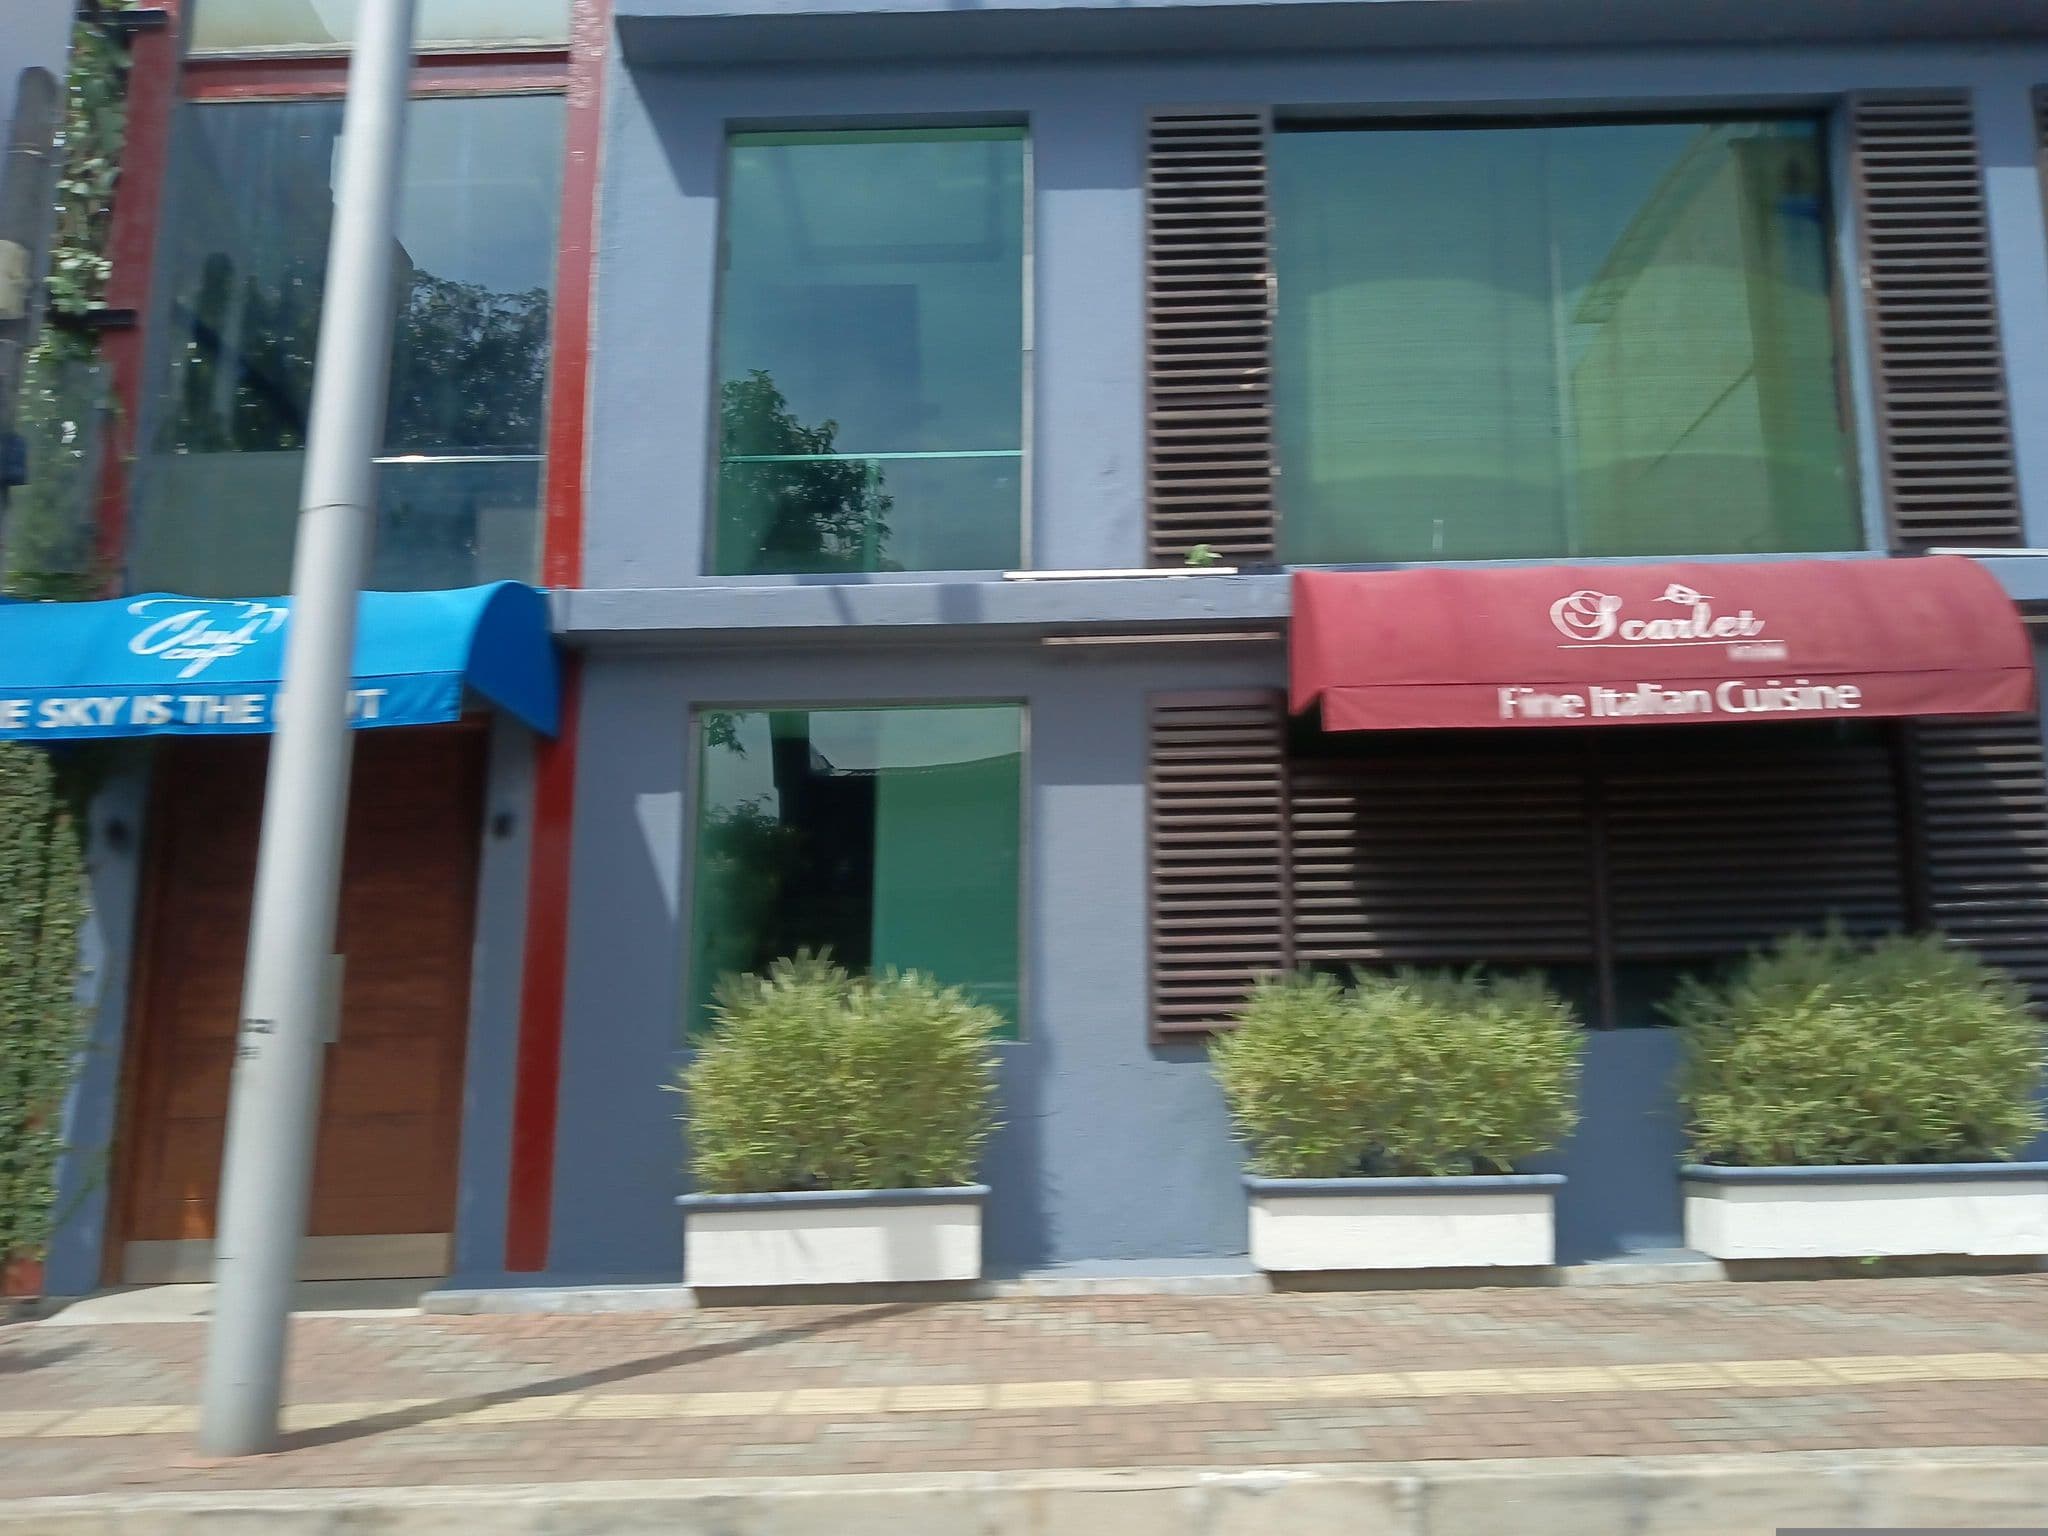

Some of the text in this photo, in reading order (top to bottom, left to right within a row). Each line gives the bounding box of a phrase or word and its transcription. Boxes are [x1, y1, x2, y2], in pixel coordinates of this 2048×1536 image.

[1550, 590, 1765, 641] Scarlet
[34, 695, 128, 728] SKY
[130, 693, 174, 726] IS
[179, 693, 266, 724] THE
[1497, 679, 1861, 719] Fine Italian Cuisine
